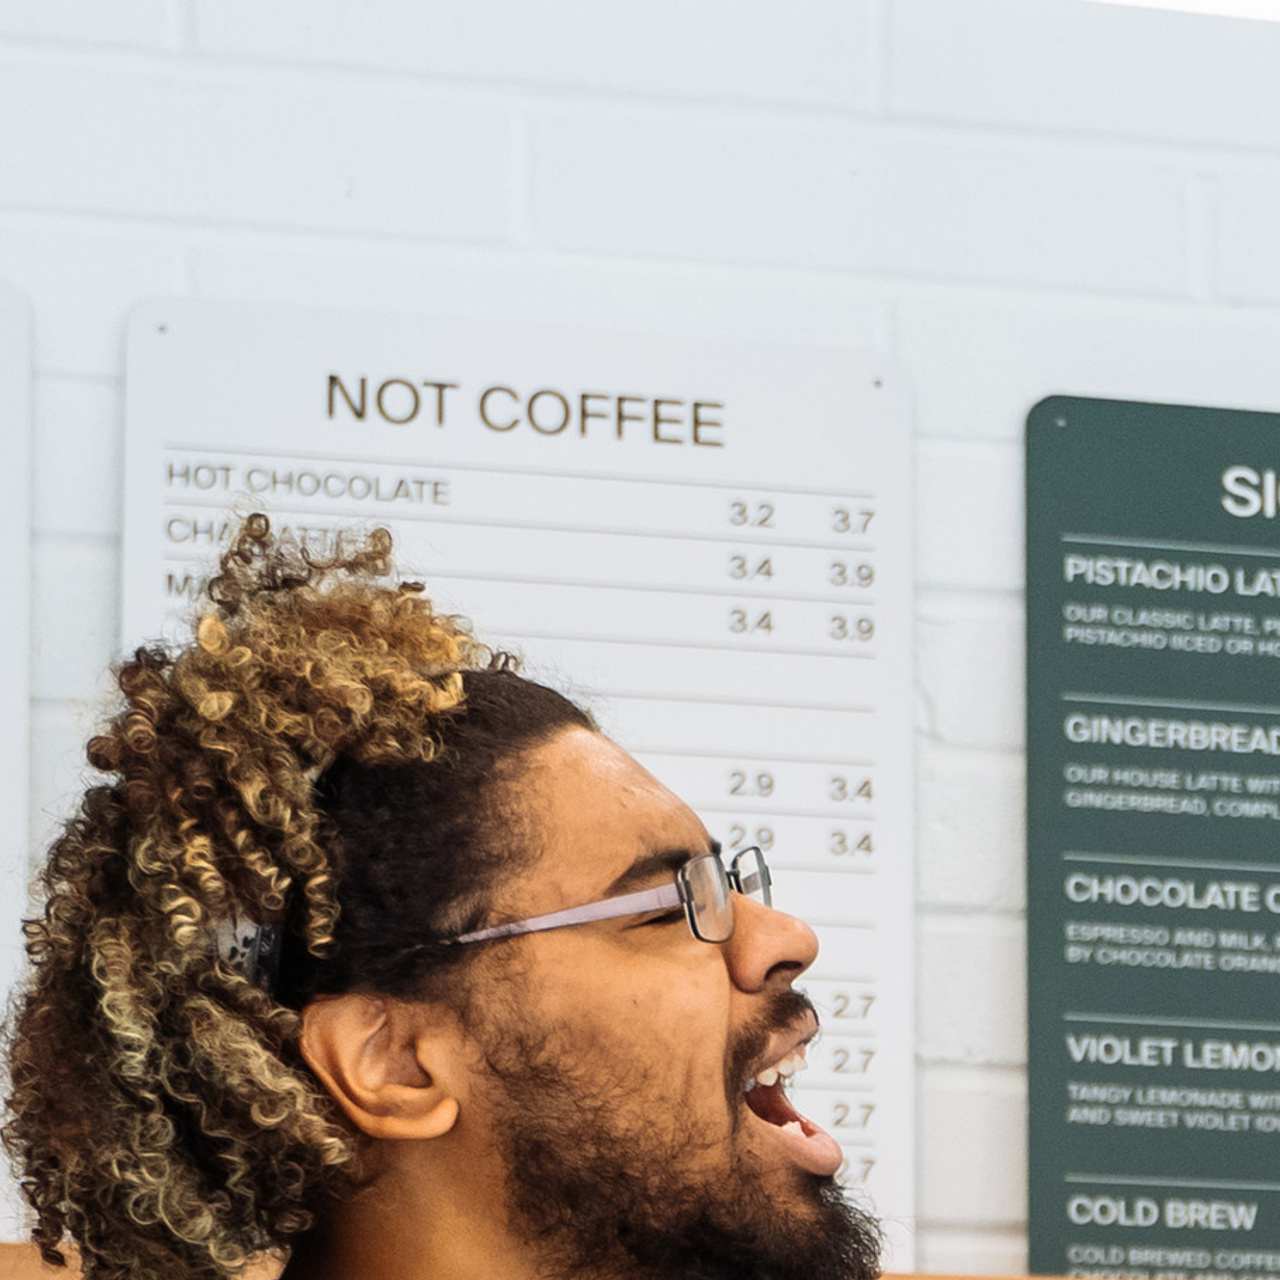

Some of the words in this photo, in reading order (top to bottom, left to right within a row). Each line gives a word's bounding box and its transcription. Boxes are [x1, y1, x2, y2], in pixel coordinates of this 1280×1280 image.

[327, 374, 460, 427] NOT
[478, 386, 725, 447] COFFEE
[168, 463, 231, 489] HOT
[247, 469, 450, 505] CHOCOLATE
[729, 502, 774, 528] 3.2
[832, 509, 875, 534] 3.7
[729, 556, 773, 581] 3.4
[830, 563, 874, 588] 3.9
[1063, 554, 1229, 593] PISTACHIO
[729, 609, 773, 634] 3.4
[830, 616, 874, 641] 3.9
[1063, 603, 1108, 622] OUR
[1110, 606, 1195, 630] CLASSIC
[1063, 624, 1168, 649] PISTACHIO
[1224, 636, 1253, 655] OR
[730, 771, 774, 797] 2.9
[831, 777, 873, 801] 3.4
[1064, 762, 1109, 783] OUR
[1111, 764, 1180, 789] HOUSE
[1186, 770, 1244, 793] LATTE
[831, 831, 873, 856] 3.4
[1064, 872, 1260, 912] CHOCOLATE
[1064, 920, 1170, 946] ESPRESSO
[1173, 927, 1216, 948] AND
[1064, 944, 1093, 963] BY
[1094, 946, 1217, 970] CHOCOLATE
[1065, 1033, 1179, 1066] VIOLET
[1067, 1081, 1132, 1104] TANGY
[1135, 1084, 1244, 1109] LEMONADE
[1067, 1105, 1111, 1125] AND
[1113, 1107, 1180, 1129] SWEET
[1183, 1110, 1249, 1132] VIOLET
[1066, 1194, 1159, 1227] COLD
[1164, 1200, 1258, 1231] BREW
[1067, 1245, 1126, 1265] COLD
[1127, 1246, 1212, 1269] BREWED
